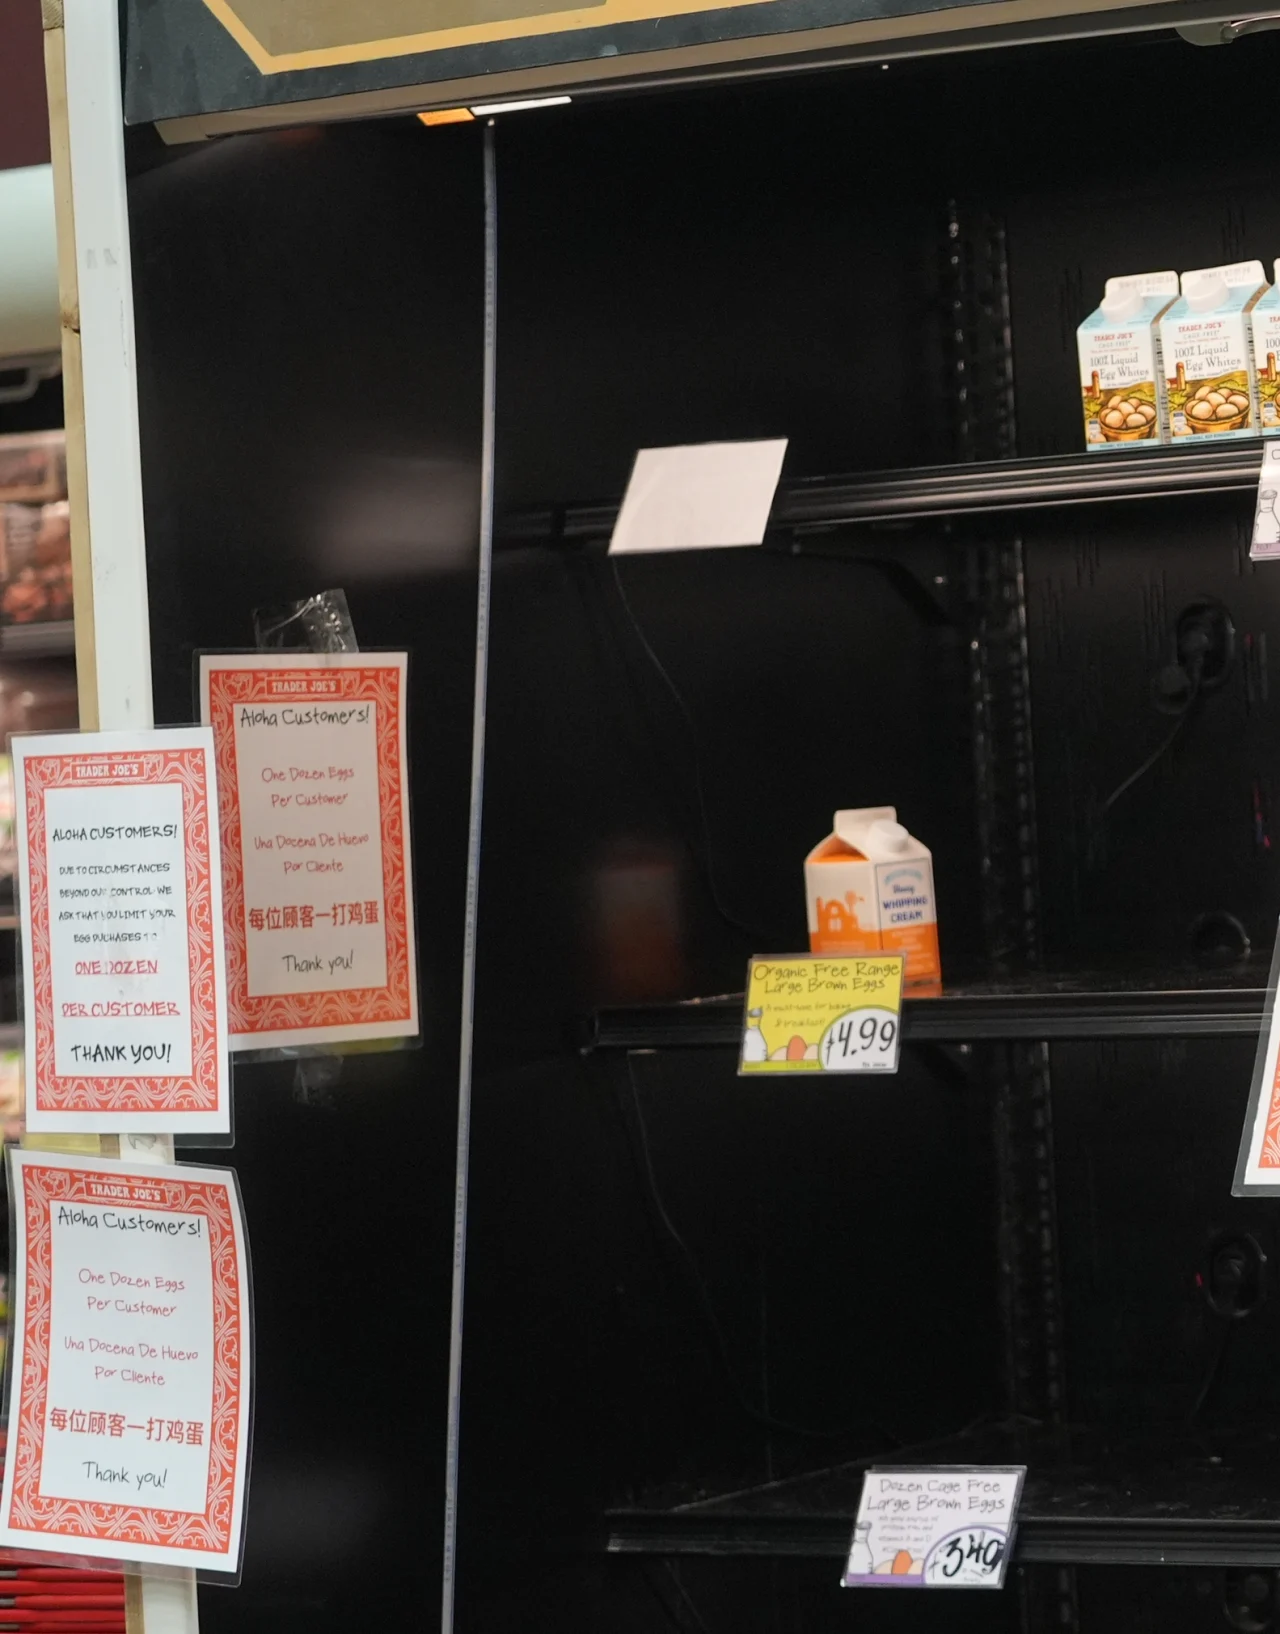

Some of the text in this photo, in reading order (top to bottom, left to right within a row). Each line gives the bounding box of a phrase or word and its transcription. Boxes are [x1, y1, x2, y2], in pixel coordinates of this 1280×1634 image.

[1178, 323, 1203, 333] TRADER
[1197, 342, 1229, 357] Liquid
[1110, 352, 1139, 366] Liquid
[1185, 356, 1242, 372] Egg Whites
[1100, 366, 1150, 381] Egg Whites
[272, 680, 337, 693] TRADER JOE'S
[240, 704, 370, 728] Aloha Customers!
[76, 763, 139, 777] TRADER JOE'S
[261, 766, 355, 783] One Dozen Eggs
[271, 792, 349, 809] Per Customer
[52, 824, 178, 842] ALOHA CUSTOMERS!
[253, 832, 370, 850] Una Docena De Huevo
[59, 863, 171, 876] DUE TO CIRCUMSTANCES
[305, 858, 345, 873] Cliente
[59, 888, 89, 899] BEYOND
[157, 885, 173, 895] WE
[882, 896, 928, 910] WHIPPING
[75, 910, 99, 921] THAT
[119, 909, 147, 920] LIMIT
[149, 909, 176, 920] YOUR
[248, 900, 380, 932] 每位顾客一打鸡蛋
[890, 910, 923, 923] CREAM
[73, 933, 92, 943] EGG
[75, 959, 159, 975] ONE DOZEN
[281, 949, 354, 975] Thank you!
[753, 963, 809, 981] Organic
[813, 963, 850, 978] Free
[856, 961, 901, 980] Range
[764, 977, 887, 995] Large Brown Eggs
[62, 1000, 181, 1017] PER CUSTOMER
[70, 1043, 172, 1064] THANK YOU!
[89, 1183, 161, 1201] TRADER JOE'S
[57, 1206, 201, 1238] Aloha Customers!
[78, 1267, 186, 1293] One Dozen Eggs
[87, 1296, 177, 1317] Per Customer
[64, 1336, 199, 1362] Una Docena De Huevo
[94, 1365, 166, 1387] Por Cliente
[48, 1406, 205, 1447] 每位顾客一打鸡蛋
[81, 1461, 169, 1491] Thank you!
[879, 1479, 1001, 1494] Dozen Cage Free
[867, 1494, 1006, 1514] Large Brown Eggs
